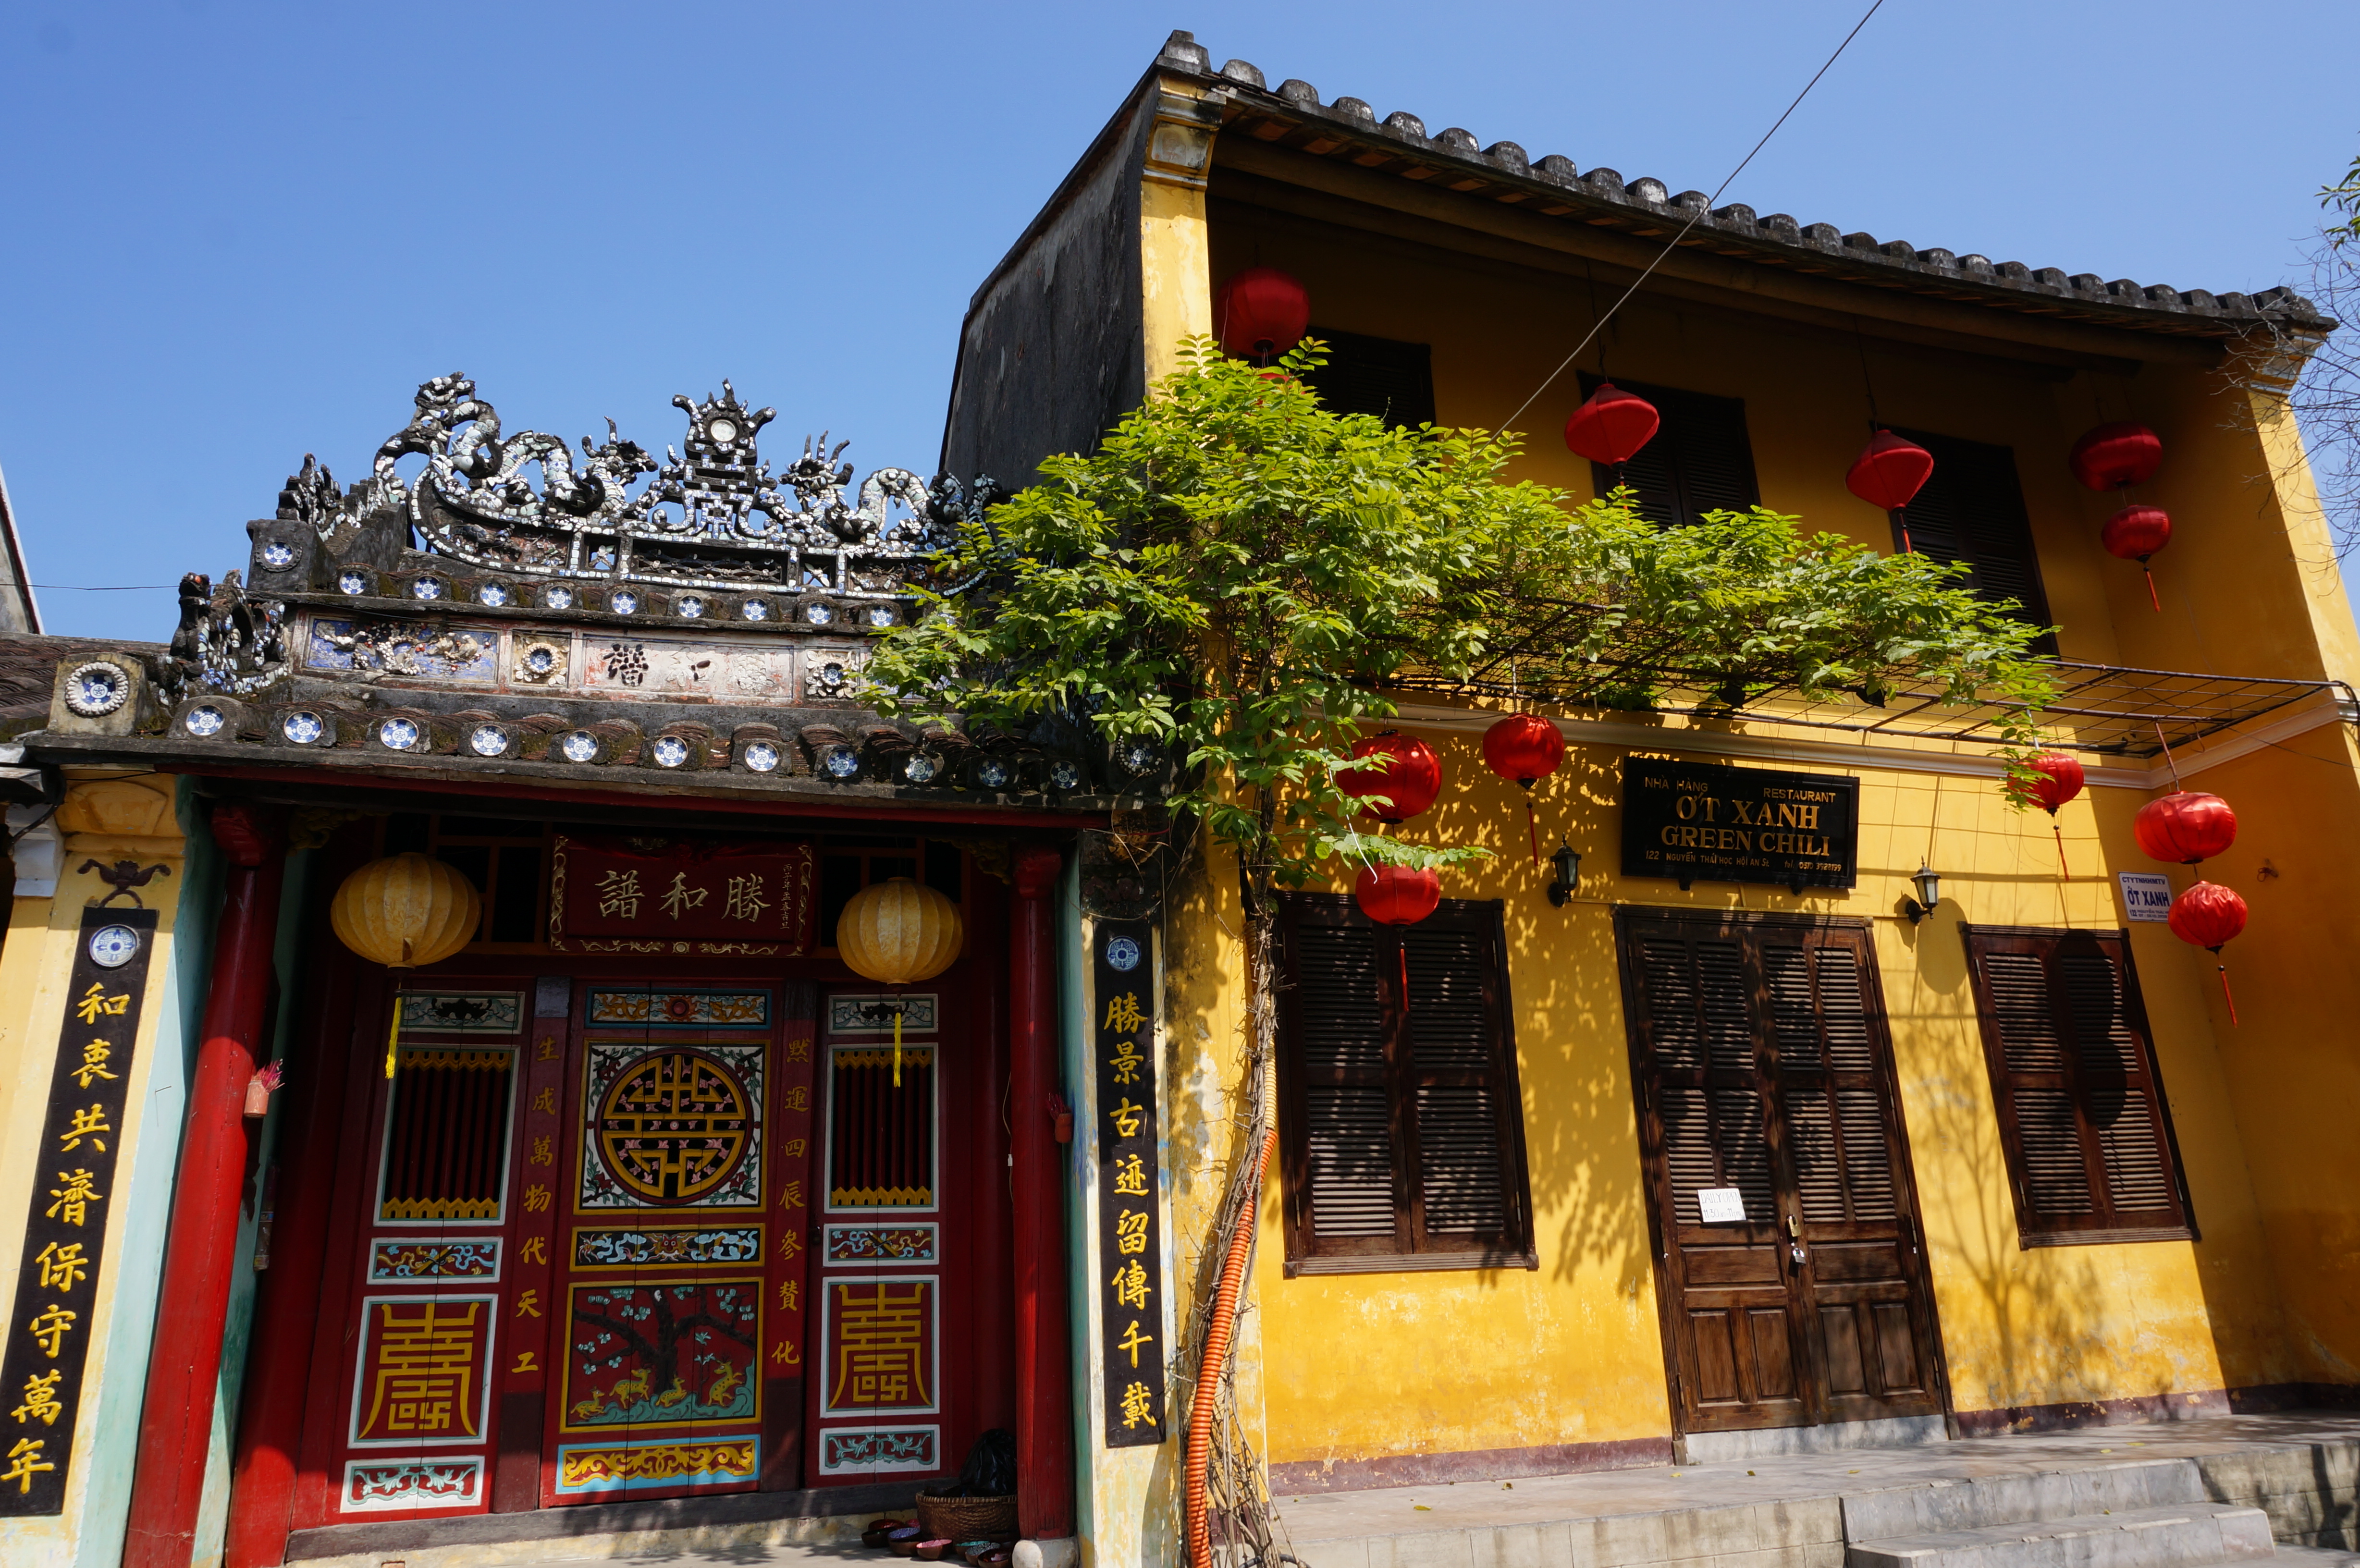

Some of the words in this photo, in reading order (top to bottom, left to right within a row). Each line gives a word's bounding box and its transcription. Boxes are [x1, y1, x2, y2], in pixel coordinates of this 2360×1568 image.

[1645, 775, 1669, 790] NHÀ
[1676, 777, 1709, 792] HÀNG
[1763, 787, 1836, 803] RESTAURANT
[1731, 800, 1820, 830] XANH
[1661, 825, 1753, 851] GREEN
[1759, 832, 1830, 857] CHILI
[1646, 850, 1659, 860] 122
[1666, 851, 1696, 863] NGUYỄN
[1700, 853, 1717, 864] THÁI
[1719, 857, 1733, 867] HỌC
[1736, 856, 1748, 867] HỘI
[2141, 890, 2170, 907] XANH
[511, 1036, 560, 1373] 生成萬物代天工
[1701, 1192, 1721, 1204] DAILY
[1722, 1191, 1741, 1203] OPEN
